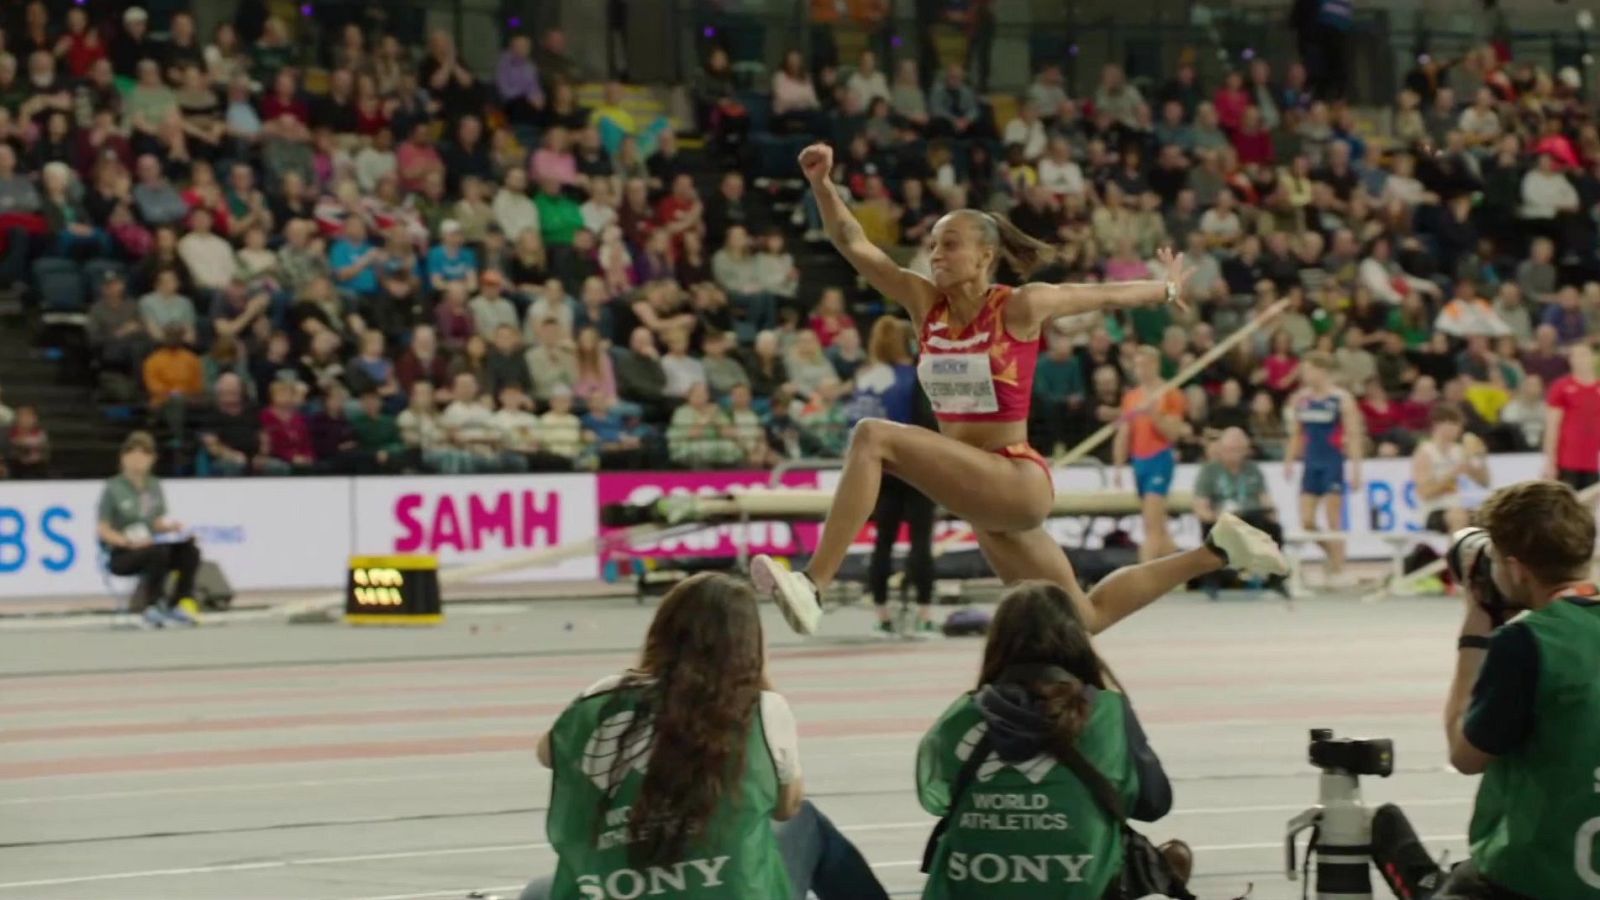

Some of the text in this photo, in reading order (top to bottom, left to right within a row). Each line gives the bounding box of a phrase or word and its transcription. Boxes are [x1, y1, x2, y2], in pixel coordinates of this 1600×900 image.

[394, 491, 559, 552] SAMH
[974, 793, 1049, 810] WORLD
[959, 813, 1068, 830] ATHLETICS
[576, 855, 731, 900] SONY
[948, 853, 1094, 883] SONY
